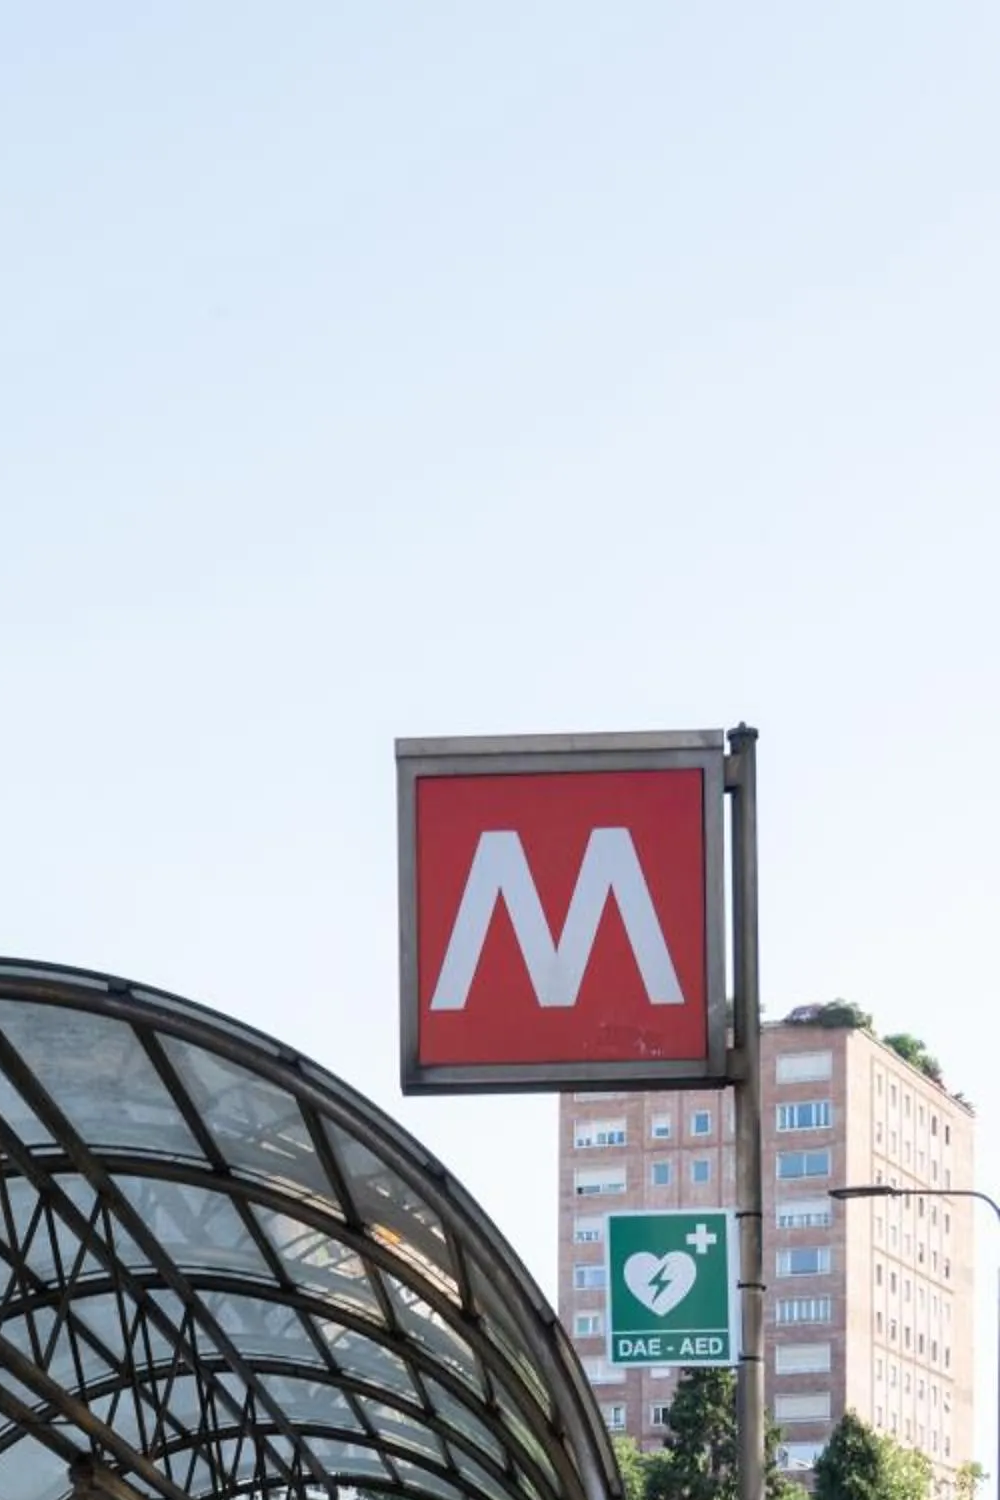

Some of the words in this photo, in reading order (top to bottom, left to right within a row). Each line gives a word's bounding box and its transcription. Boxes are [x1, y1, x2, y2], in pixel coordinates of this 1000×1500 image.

[430, 827, 685, 1010] M
[617, 1338, 661, 1357] DAE
[679, 1337, 723, 1356] AED
